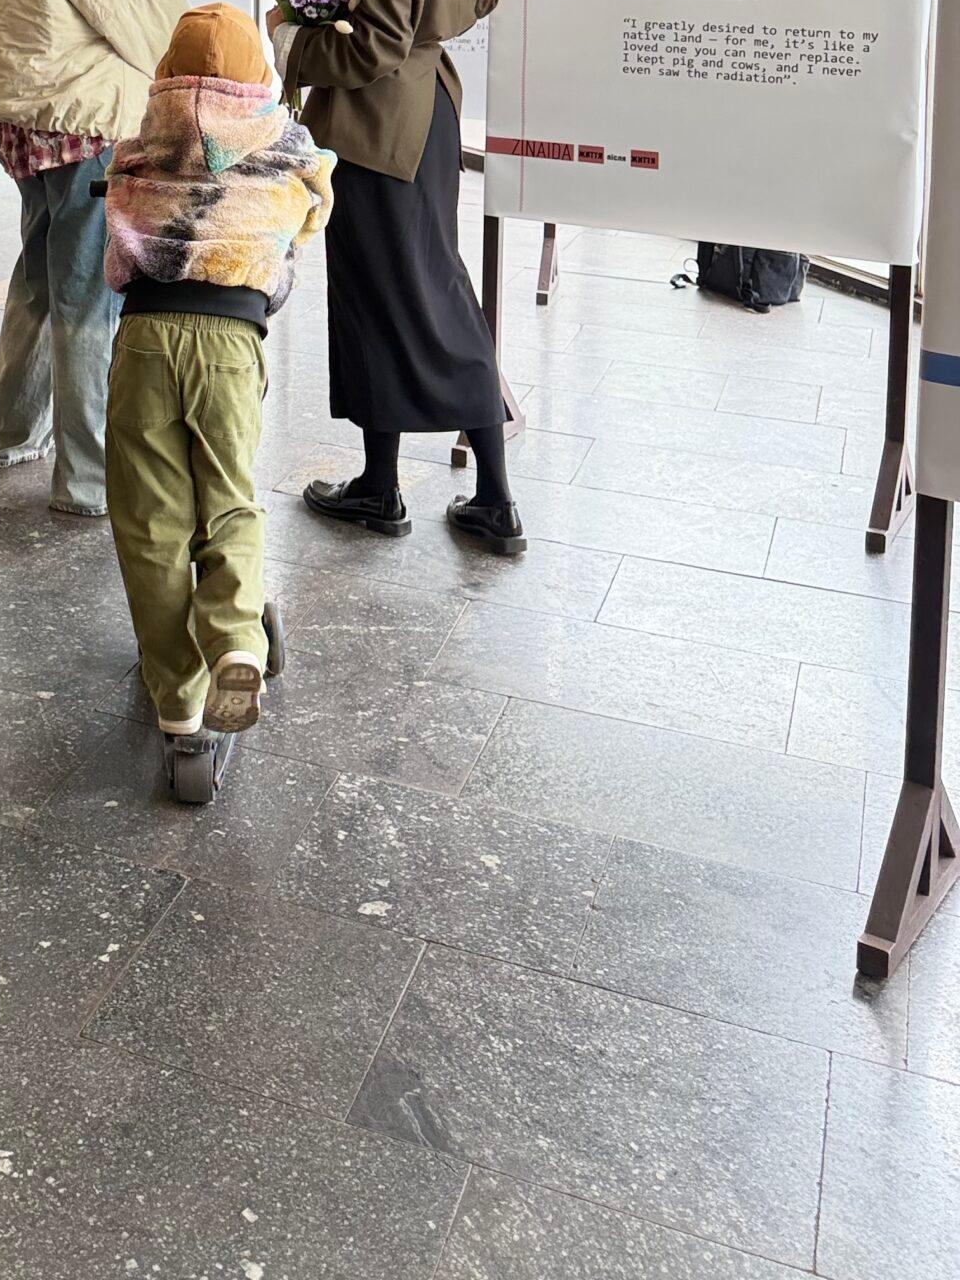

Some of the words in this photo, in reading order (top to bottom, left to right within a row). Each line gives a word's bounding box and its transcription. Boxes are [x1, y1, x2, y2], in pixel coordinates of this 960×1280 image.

[623, 30, 666, 41] native
[673, 32, 702, 43] land
[724, 34, 747, 46] for
[753, 38, 775, 50] me,
[823, 40, 855, 52] like
[862, 44, 870, 53] a
[644, 20, 695, 33] greatly
[702, 22, 755, 34] desired
[762, 25, 777, 36] to
[784, 28, 831, 39] return
[839, 29, 855, 40] to
[862, 32, 879, 43] my
[622, 40, 658, 52] loved
[665, 45, 687, 54] one
[694, 47, 717, 57] you
[724, 48, 746, 58] can
[753, 50, 791, 60] never
[799, 52, 860, 65] replace.
[622, 52, 629, 63] I
[636, 53, 665, 66] kept
[672, 56, 694, 69] pig
[701, 58, 724, 69] and
[730, 60, 766, 73] cows,
[776, 63, 799, 73] and
[807, 64, 814, 74] I
[822, 66, 861, 77] never
[622, 65, 651, 75] even
[658, 67, 680, 77] saw
[686, 68, 708, 79] the
[511, 139, 572, 161] ZINAIDA
